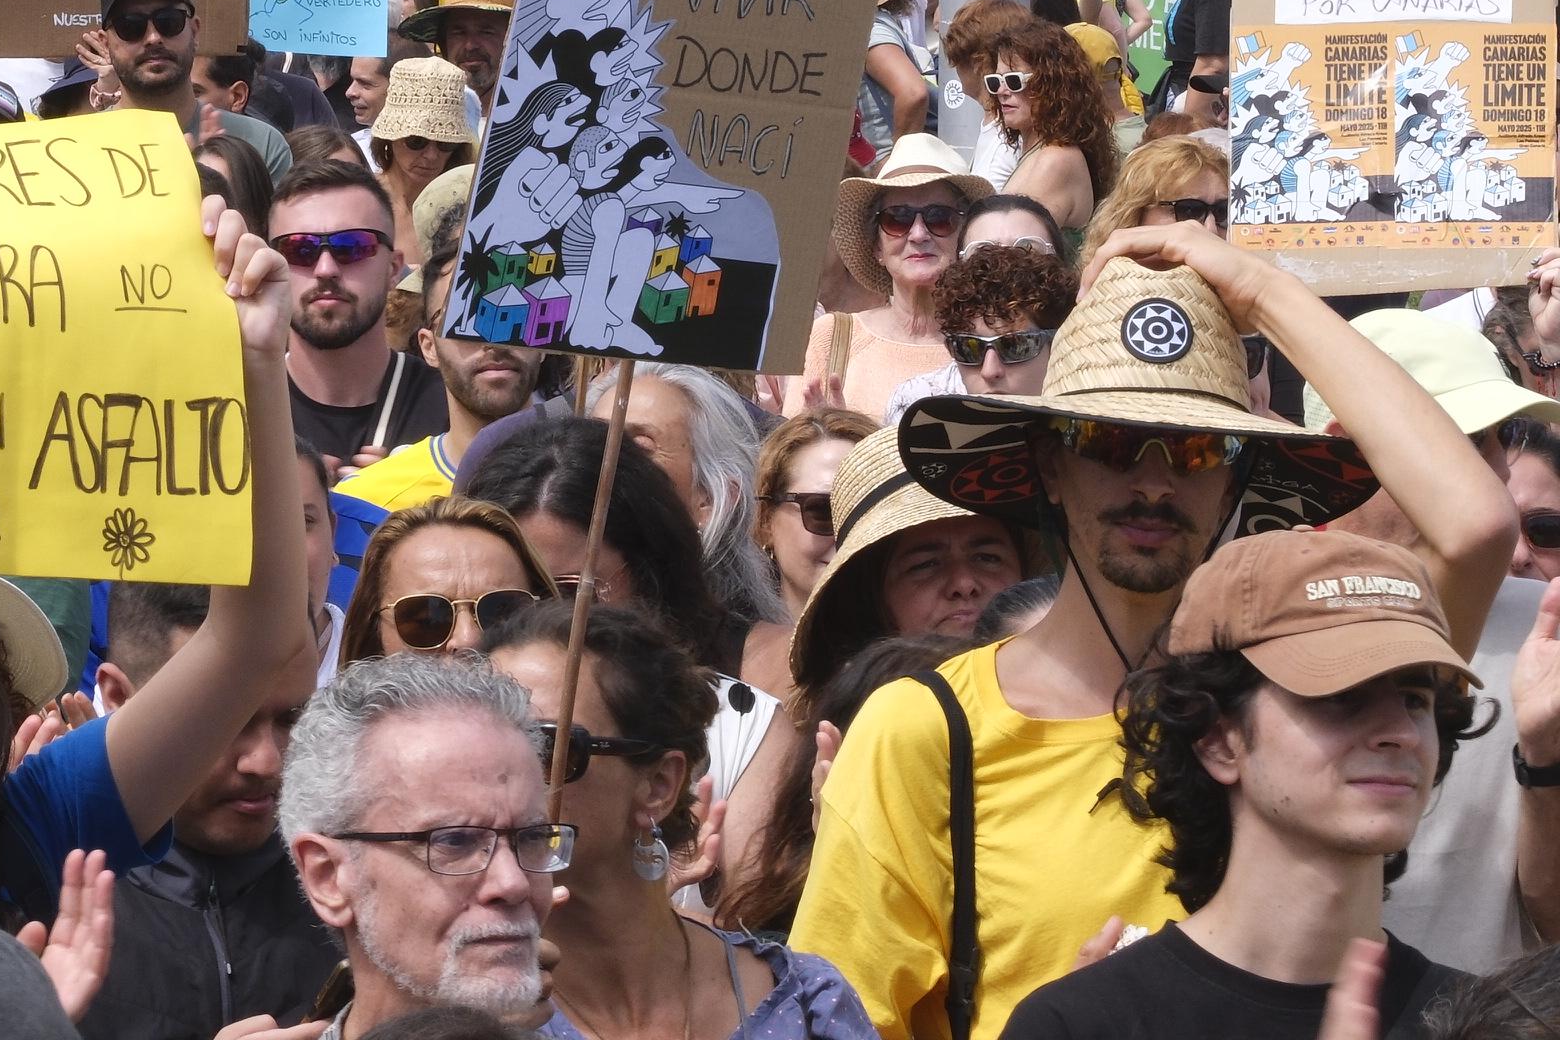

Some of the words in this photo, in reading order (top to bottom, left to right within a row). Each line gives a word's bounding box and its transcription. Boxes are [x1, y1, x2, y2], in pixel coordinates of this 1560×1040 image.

[53, 12, 103, 27] NUESTR
[263, 29, 287, 41] SON
[1325, 32, 1387, 45] MANIFESTACIÓN
[1484, 33, 1546, 45] MANIFESTACIÓN
[1325, 46, 1387, 62] CANARIAS
[1483, 46, 1546, 62] CANARIAS
[672, 35, 828, 96] DONDE
[1325, 63, 1365, 82] TIENE
[1483, 63, 1523, 81] TIENE
[1527, 63, 1546, 81] UN
[1483, 80, 1546, 106] LÍMITE
[1325, 108, 1374, 121] DOMINGO
[1376, 107, 1387, 120] 18
[1483, 109, 1532, 121] DOMINGO
[1534, 109, 1546, 121] 18
[1341, 124, 1357, 132] MAYO
[1498, 124, 1515, 132] MAYO
[1516, 124, 1532, 132] 2025
[686, 109, 804, 179] NACÍ
[1306, 579, 1340, 600] SAN
[1341, 576, 1421, 600] FRANCISCO
